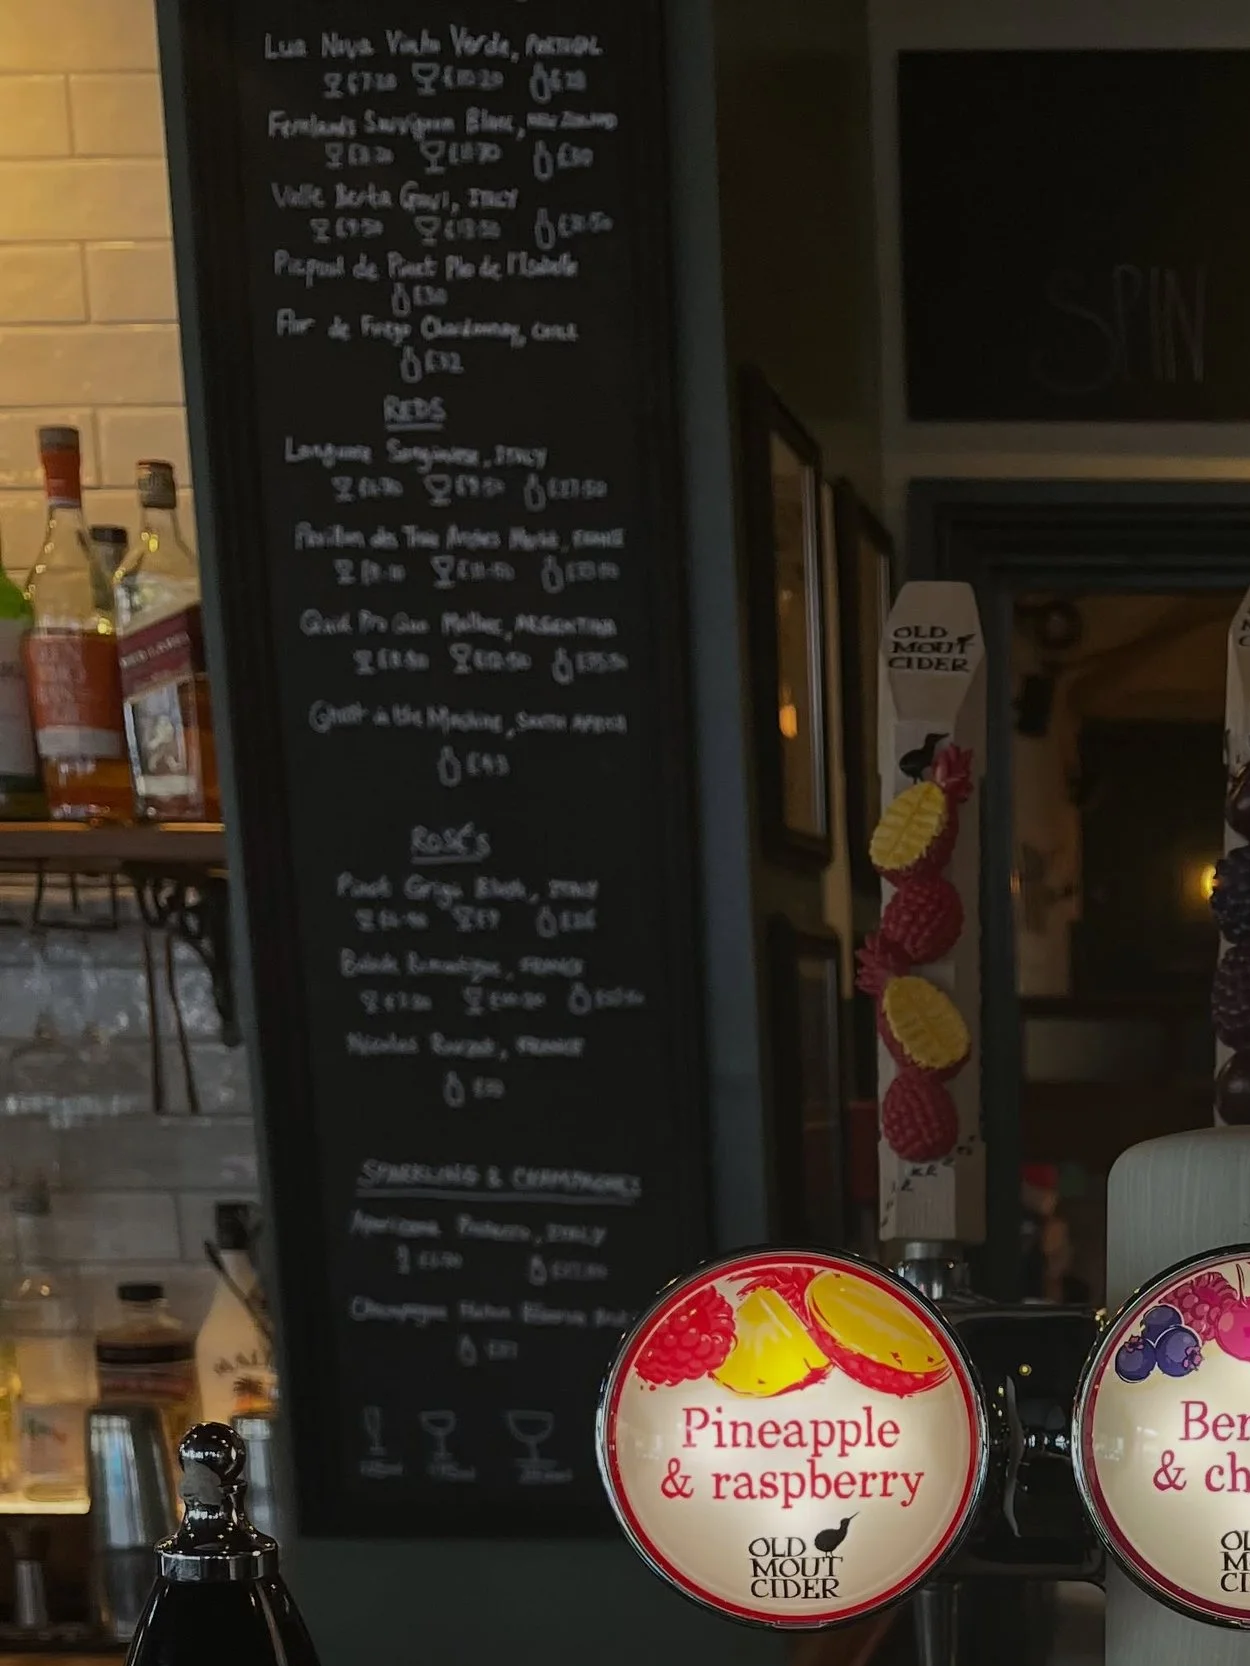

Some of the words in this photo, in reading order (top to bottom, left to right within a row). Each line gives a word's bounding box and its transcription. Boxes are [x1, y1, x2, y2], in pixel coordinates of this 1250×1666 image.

[383, 394, 447, 424] REDS
[894, 626, 947, 638] OLD
[893, 641, 974, 654] MOUT
[888, 657, 969, 672] CIDER
[682, 1406, 900, 1457] Pineapple
[1153, 1450, 1187, 1493] &
[661, 1458, 694, 1500] &
[712, 1459, 925, 1508] raspberry
[748, 1536, 807, 1558] OLD
[749, 1556, 843, 1578] MOUT
[750, 1578, 842, 1599] CIDER
